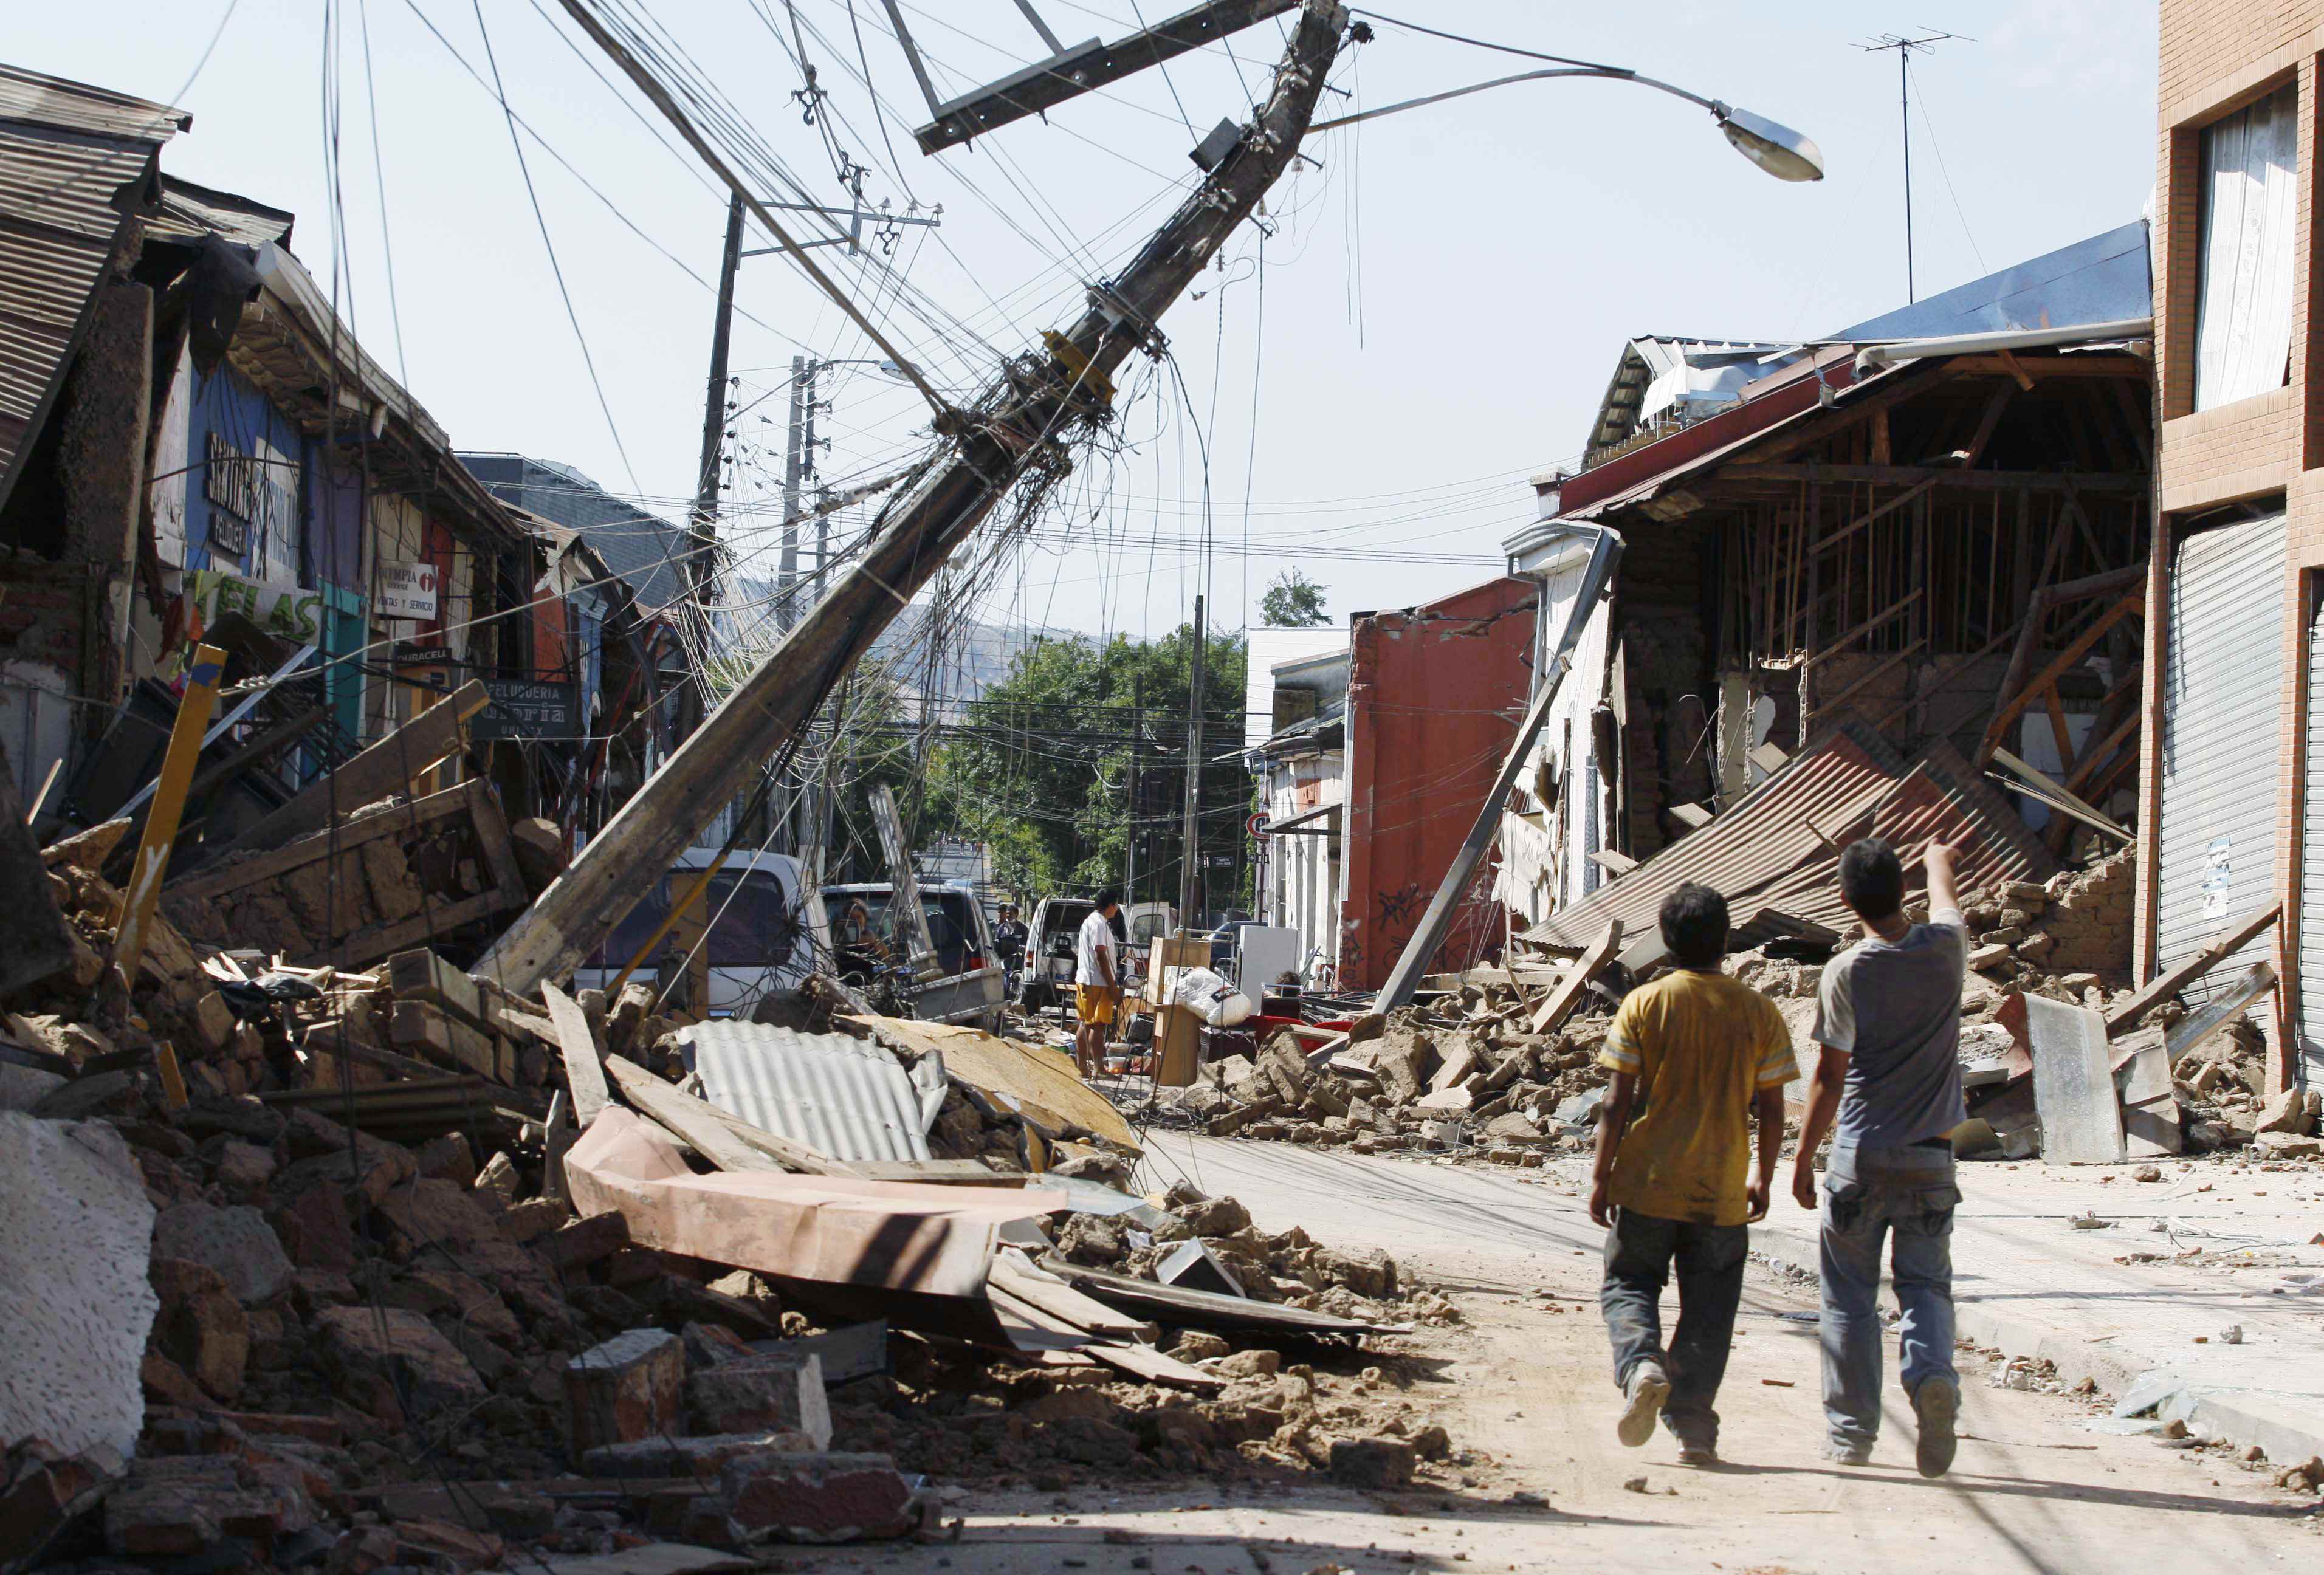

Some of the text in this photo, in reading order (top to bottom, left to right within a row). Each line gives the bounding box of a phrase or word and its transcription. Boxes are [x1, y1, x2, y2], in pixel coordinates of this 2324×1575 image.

[185, 575, 322, 641] TELAS
[402, 599, 407, 608] Y
[398, 649, 448, 662] DURACELL
[487, 684, 560, 699] PELUQUERIA
[501, 724, 543, 736] UNIX
